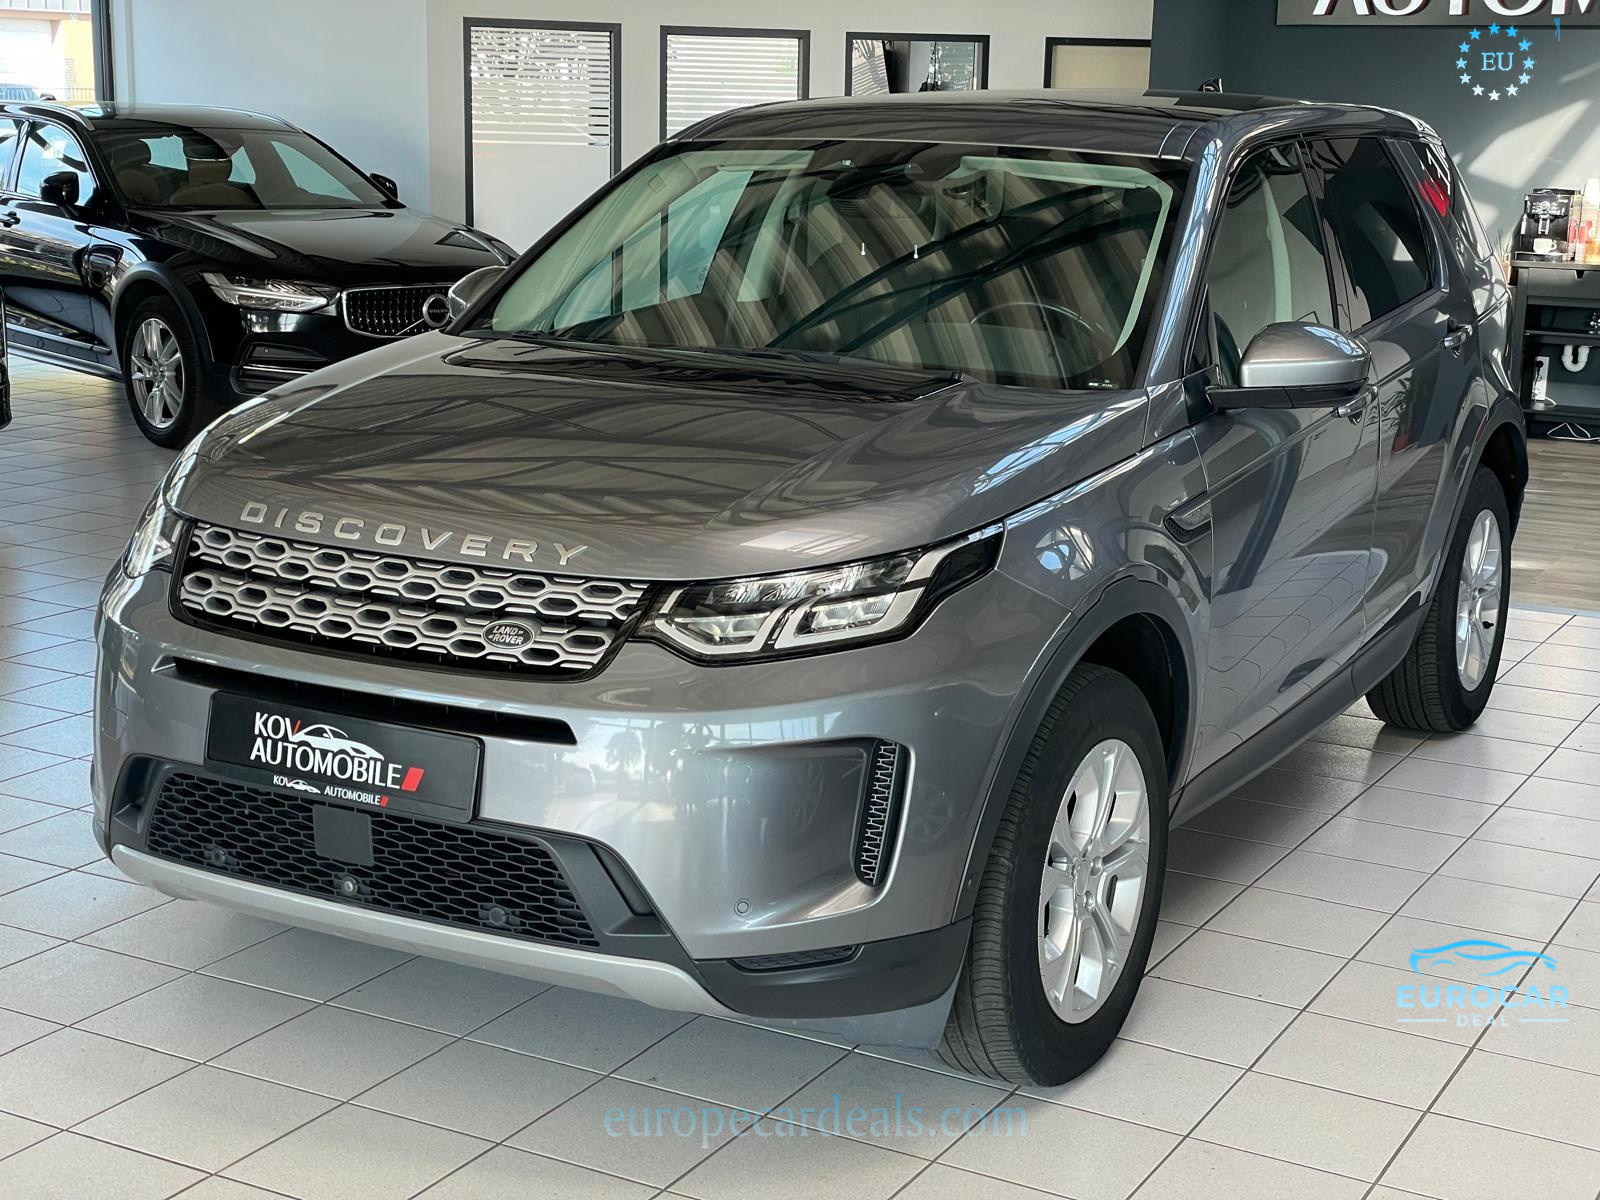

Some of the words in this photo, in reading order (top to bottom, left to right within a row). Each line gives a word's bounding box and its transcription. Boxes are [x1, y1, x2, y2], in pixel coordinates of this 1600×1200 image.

[240, 501, 588, 566] DISCOVERY
[492, 625, 519, 635] LAND
[492, 633, 524, 645] ROVER
[254, 711, 302, 742] KOV
[250, 737, 402, 790] AUTOMOBILE
[324, 785, 382, 806] AUTOMOBILE
